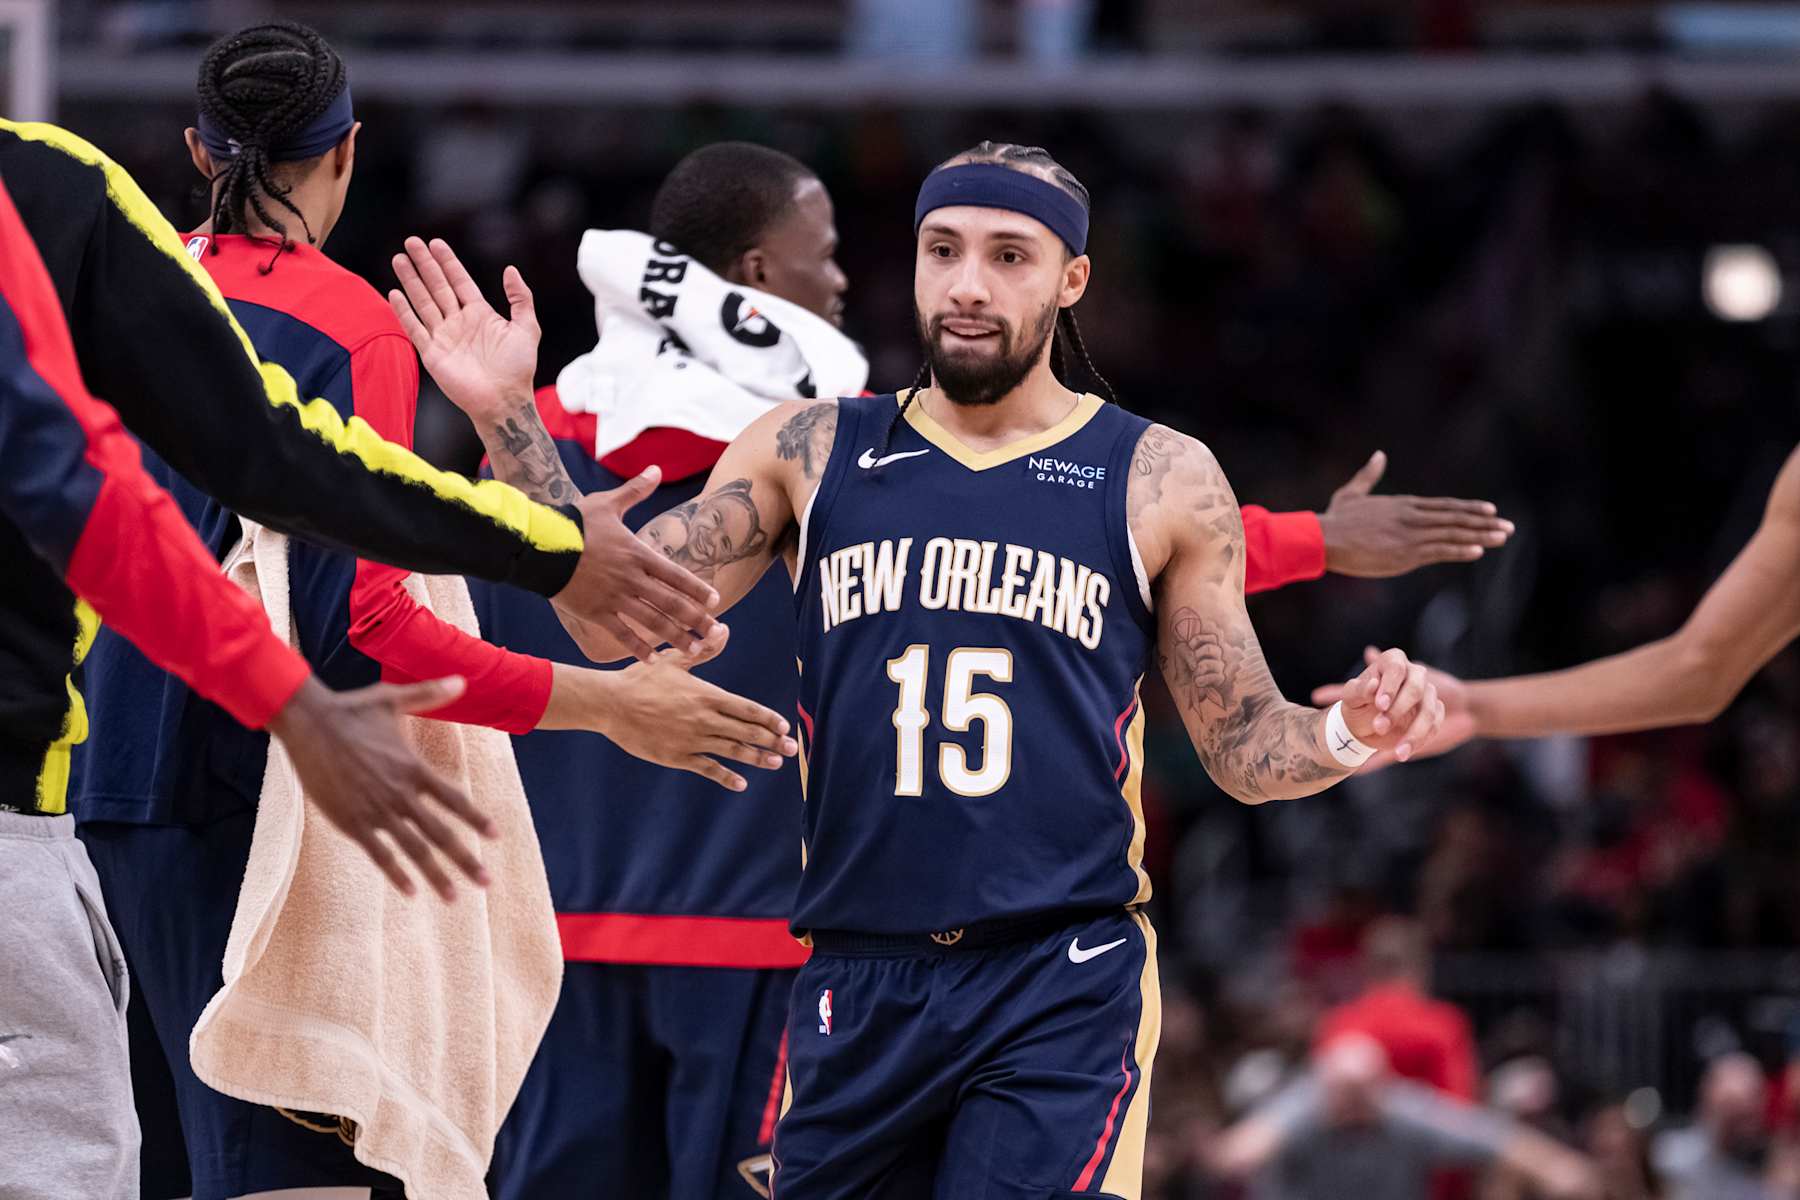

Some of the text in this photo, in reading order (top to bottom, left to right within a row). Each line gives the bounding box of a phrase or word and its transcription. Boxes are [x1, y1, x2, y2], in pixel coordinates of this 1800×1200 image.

[1028, 456, 1106, 480] NEWAGE
[1036, 472, 1095, 489] GARAGE
[819, 536, 1111, 651] NEW ORLEANS
[886, 643, 1014, 798] 15
